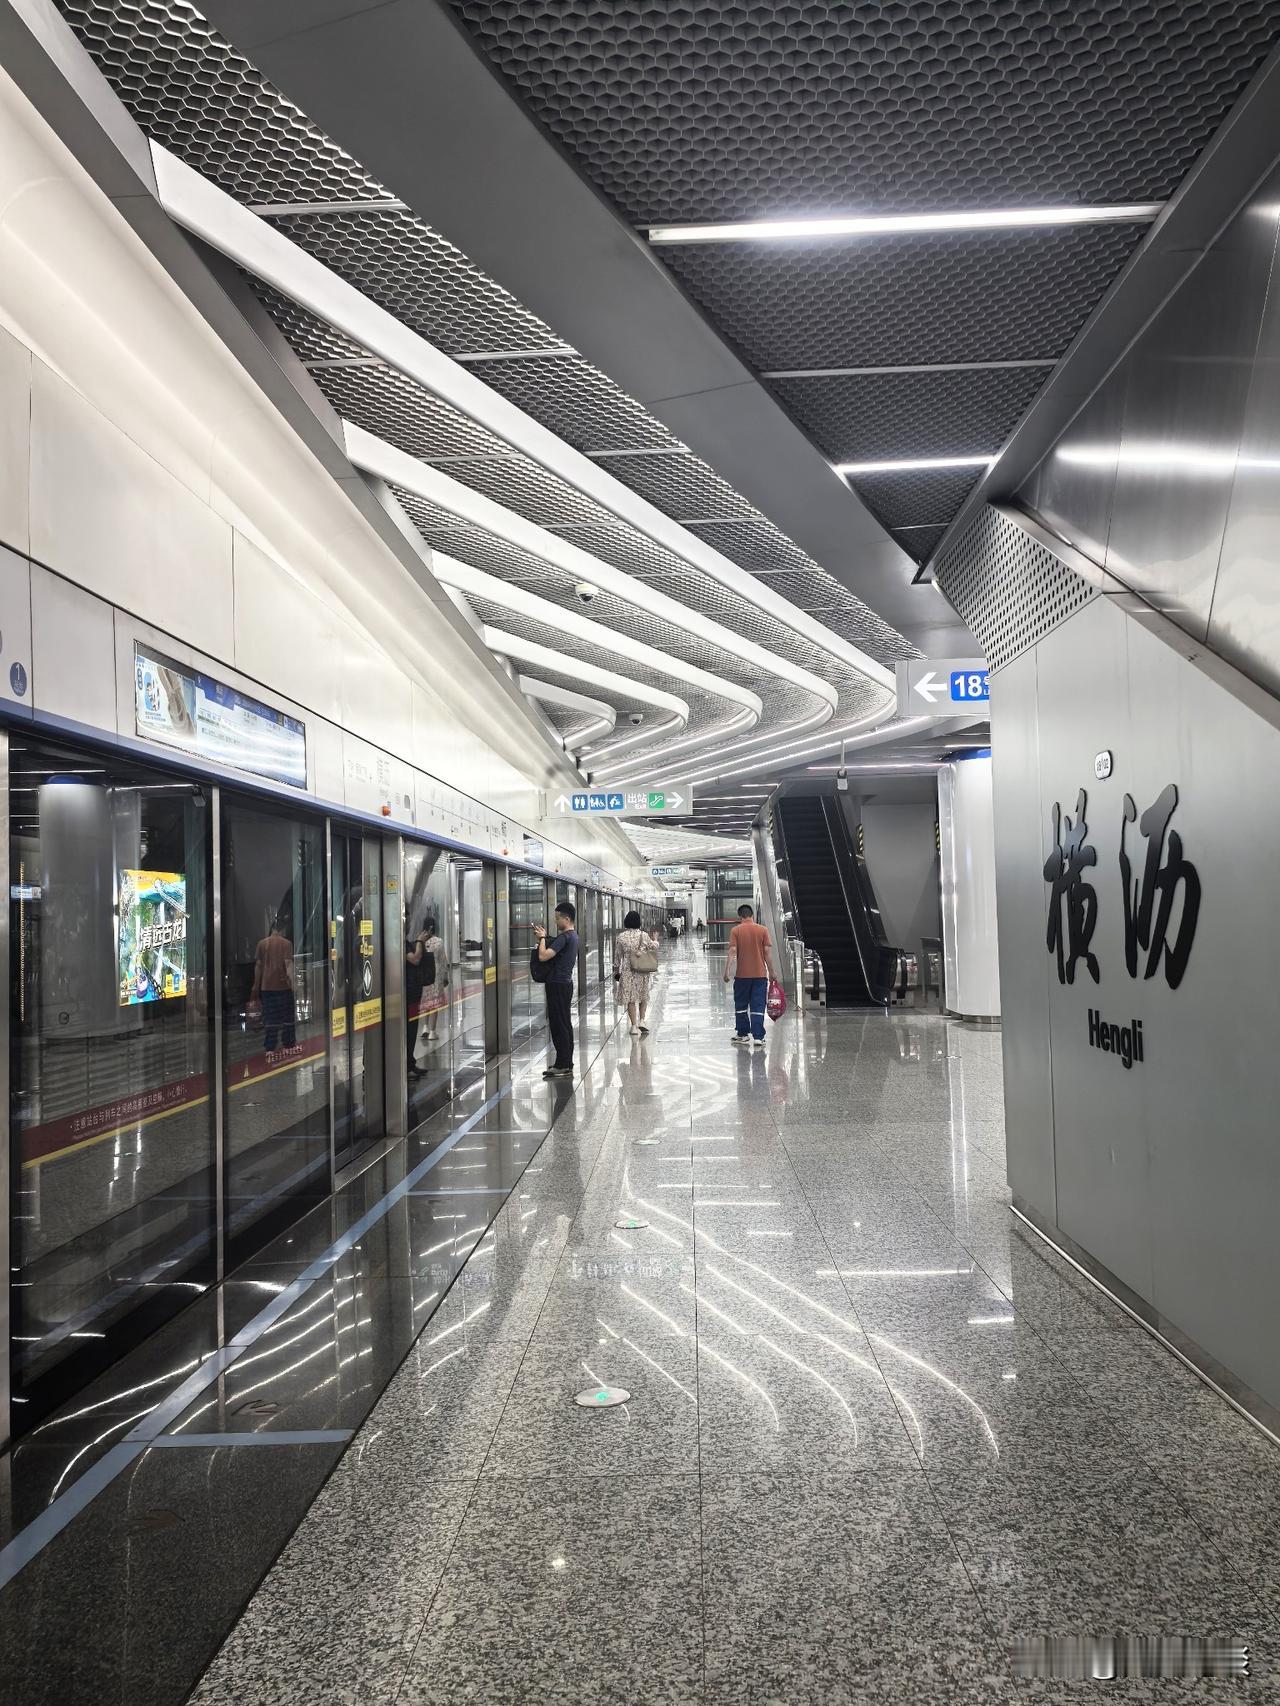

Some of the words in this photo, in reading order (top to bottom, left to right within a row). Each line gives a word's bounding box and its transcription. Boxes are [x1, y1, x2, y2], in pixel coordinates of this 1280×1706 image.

[954, 675, 983, 697] 18
[627, 793, 647, 804] 出站
[140, 917, 186, 951] 清远古龙
[1088, 1008, 1144, 1070] Hengli
